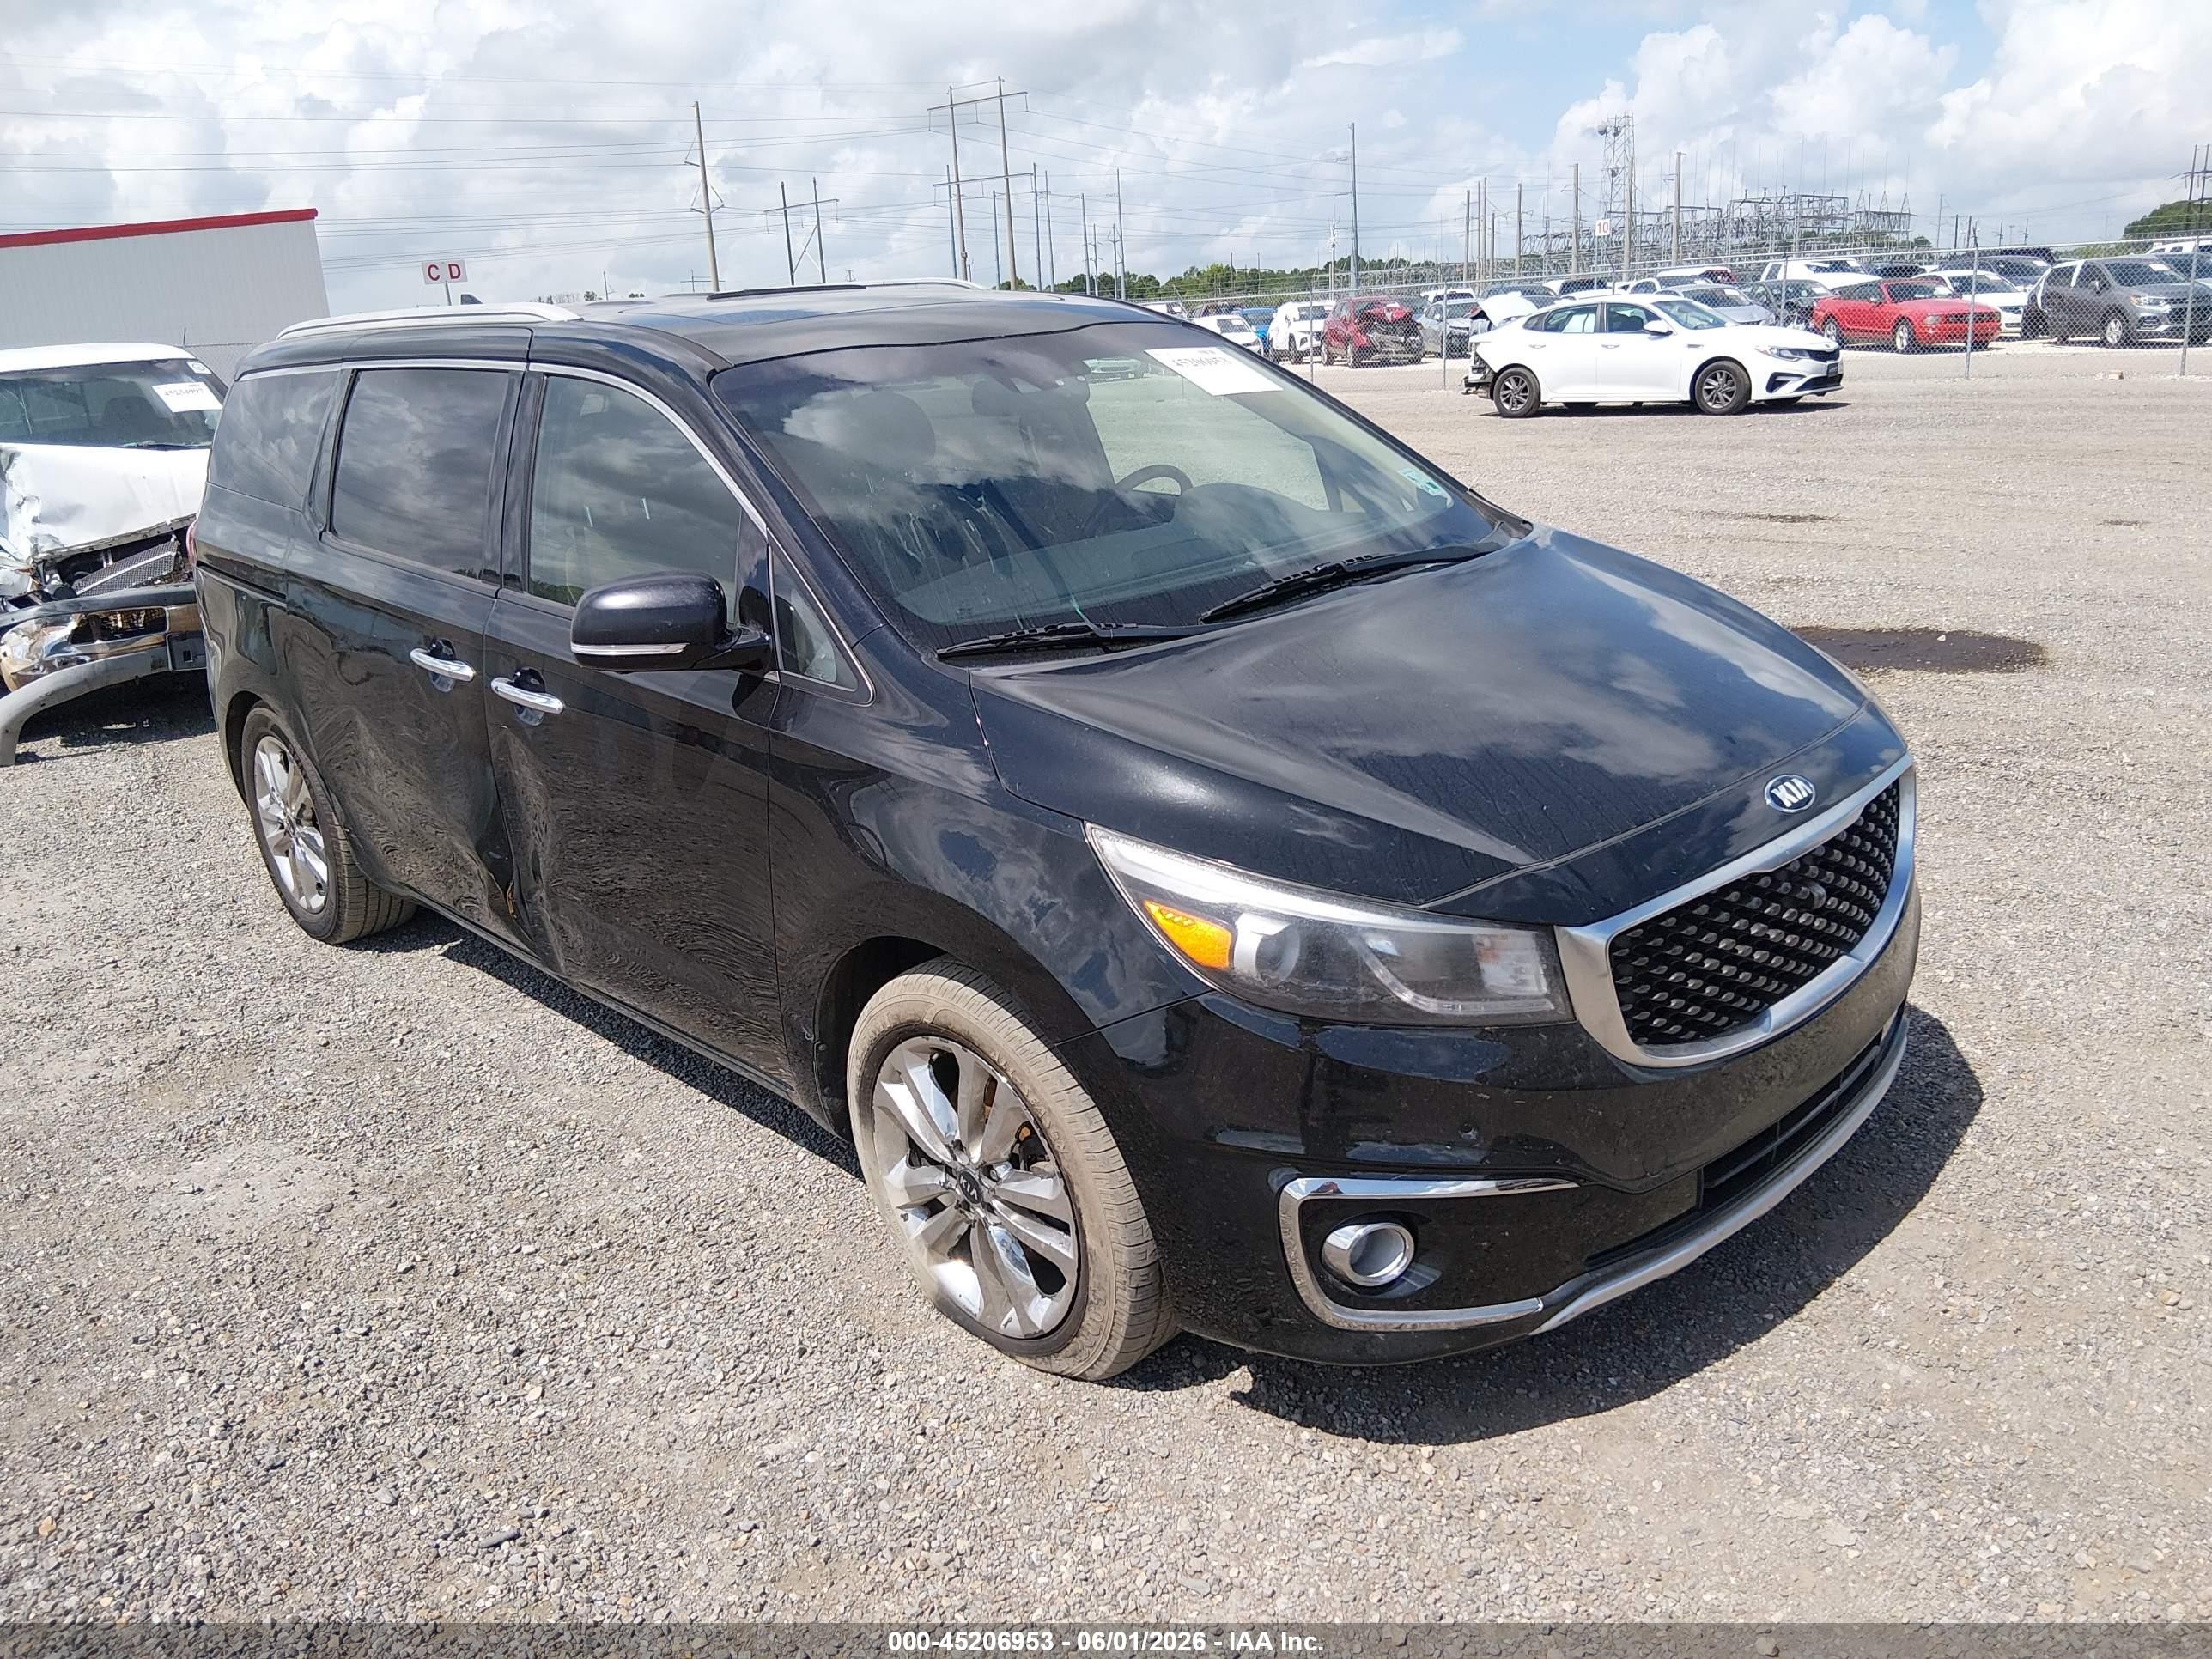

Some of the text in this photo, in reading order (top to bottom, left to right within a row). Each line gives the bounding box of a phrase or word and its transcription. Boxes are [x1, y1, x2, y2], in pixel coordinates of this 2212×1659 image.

[1597, 222, 1608, 234] 10
[428, 263, 461, 281] C D
[1771, 778, 1813, 807] KIA
[960, 1175, 978, 1200] KIA
